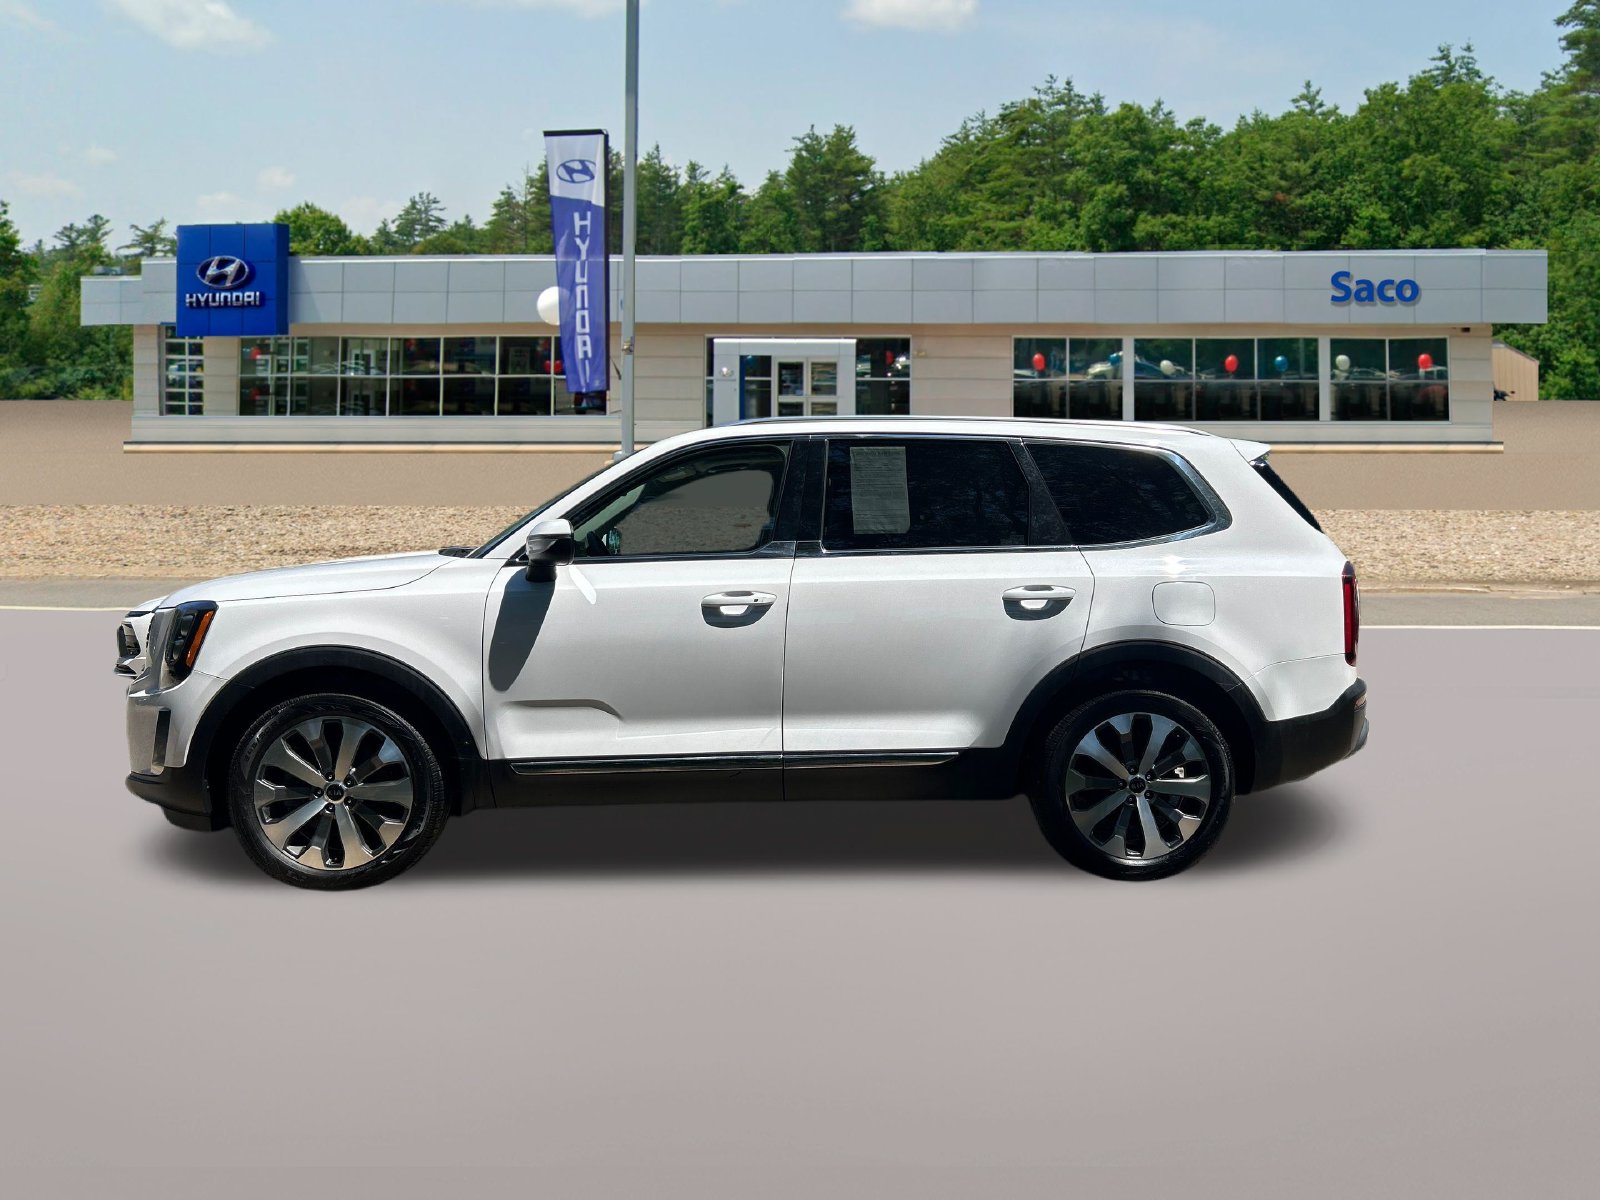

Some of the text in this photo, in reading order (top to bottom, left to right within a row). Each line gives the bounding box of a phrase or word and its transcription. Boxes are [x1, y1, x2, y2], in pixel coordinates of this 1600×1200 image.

[185, 291, 260, 307] HYUNDAI
[574, 211, 592, 383] HYUNDAI
[1331, 271, 1419, 303] Saco
